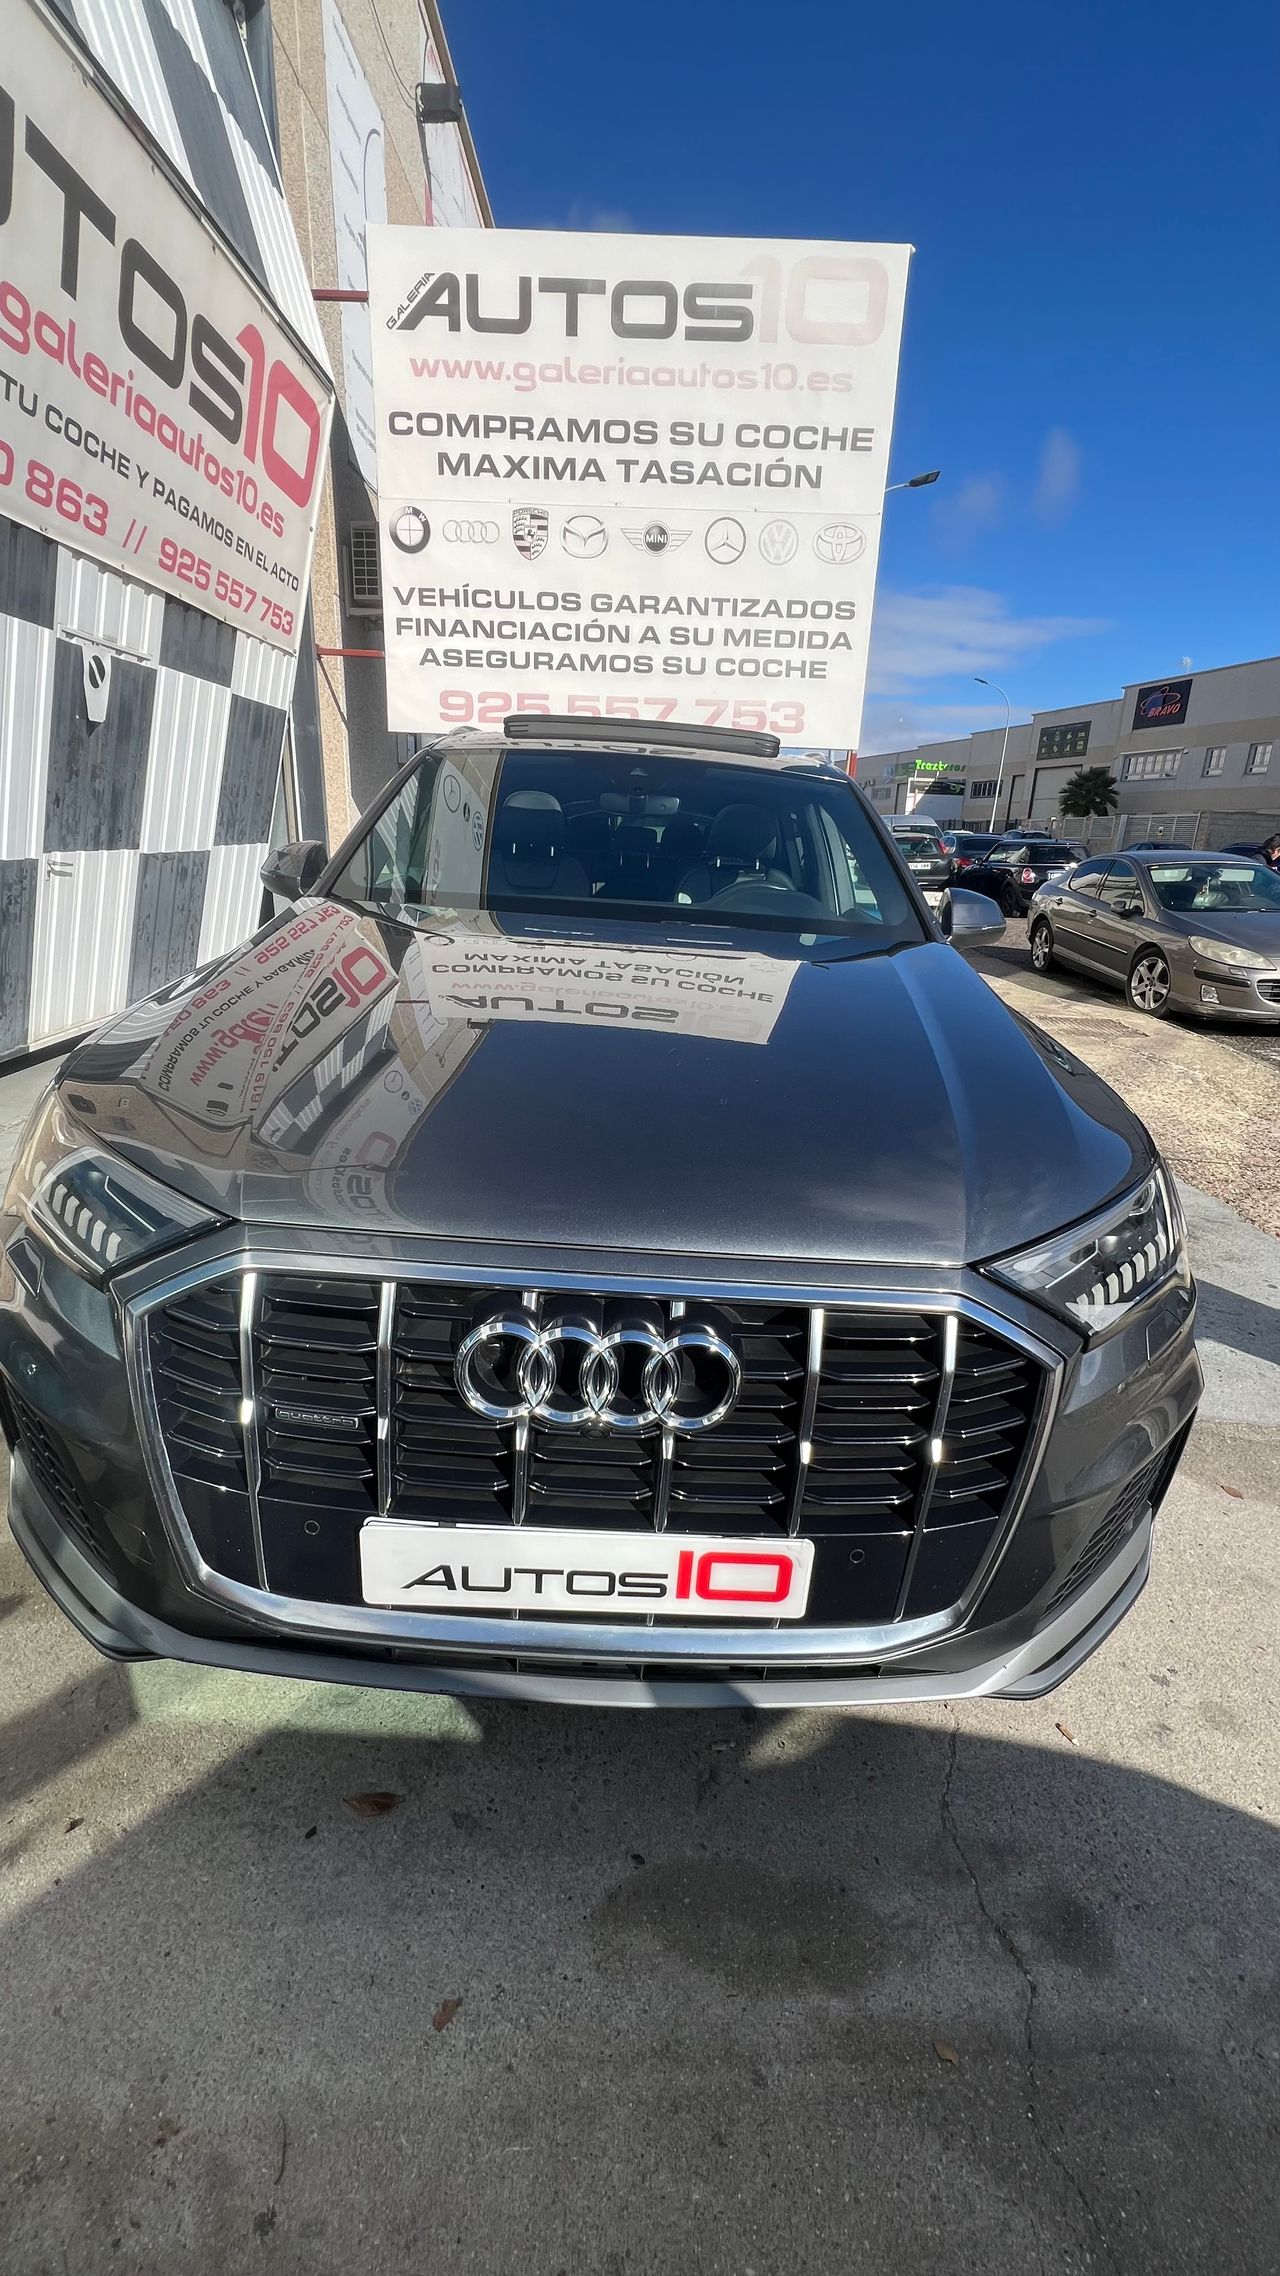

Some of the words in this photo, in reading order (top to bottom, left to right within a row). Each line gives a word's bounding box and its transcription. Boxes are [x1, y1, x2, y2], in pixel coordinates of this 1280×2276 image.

[0, 84, 320, 508] TOS10
[386, 272, 436, 330] GALERIA
[409, 356, 853, 393] www.galeriaautos10.es
[388, 411, 658, 445] COMPRAMOS
[669, 421, 724, 447] SU
[735, 423, 875, 452] COCHE
[437, 452, 606, 483] MAXIMA
[616, 456, 823, 489] TASACIÓN
[45, 403, 131, 480] COCHE
[136, 463, 150, 489] Y
[152, 477, 234, 548] PAGAMOS
[235, 535, 254, 562] EN
[256, 550, 269, 573] EL
[270, 562, 299, 592] ACTO
[25, 458, 109, 537] 863
[158, 536, 212, 591] 925
[214, 568, 257, 613] 557
[259, 595, 295, 636] 753
[646, 533, 667, 544] MINI
[393, 583, 581, 611] VEHÍCULOS
[590, 593, 856, 620] GARANTIZADOS
[396, 617, 630, 644] FINANCIACIÓN
[638, 625, 661, 645] A
[669, 626, 714, 647] SU
[723, 628, 853, 651] MEDIDA
[419, 648, 653, 673] ASEGURAMOS
[662, 656, 706, 675] SU
[715, 658, 828, 679] COCHE
[439, 690, 550, 723] 925
[567, 693, 678, 721] 557
[695, 697, 805, 734] 753
[1148, 702, 1181, 718] BRAVO
[400, 1550, 794, 1603] AUTOS10
